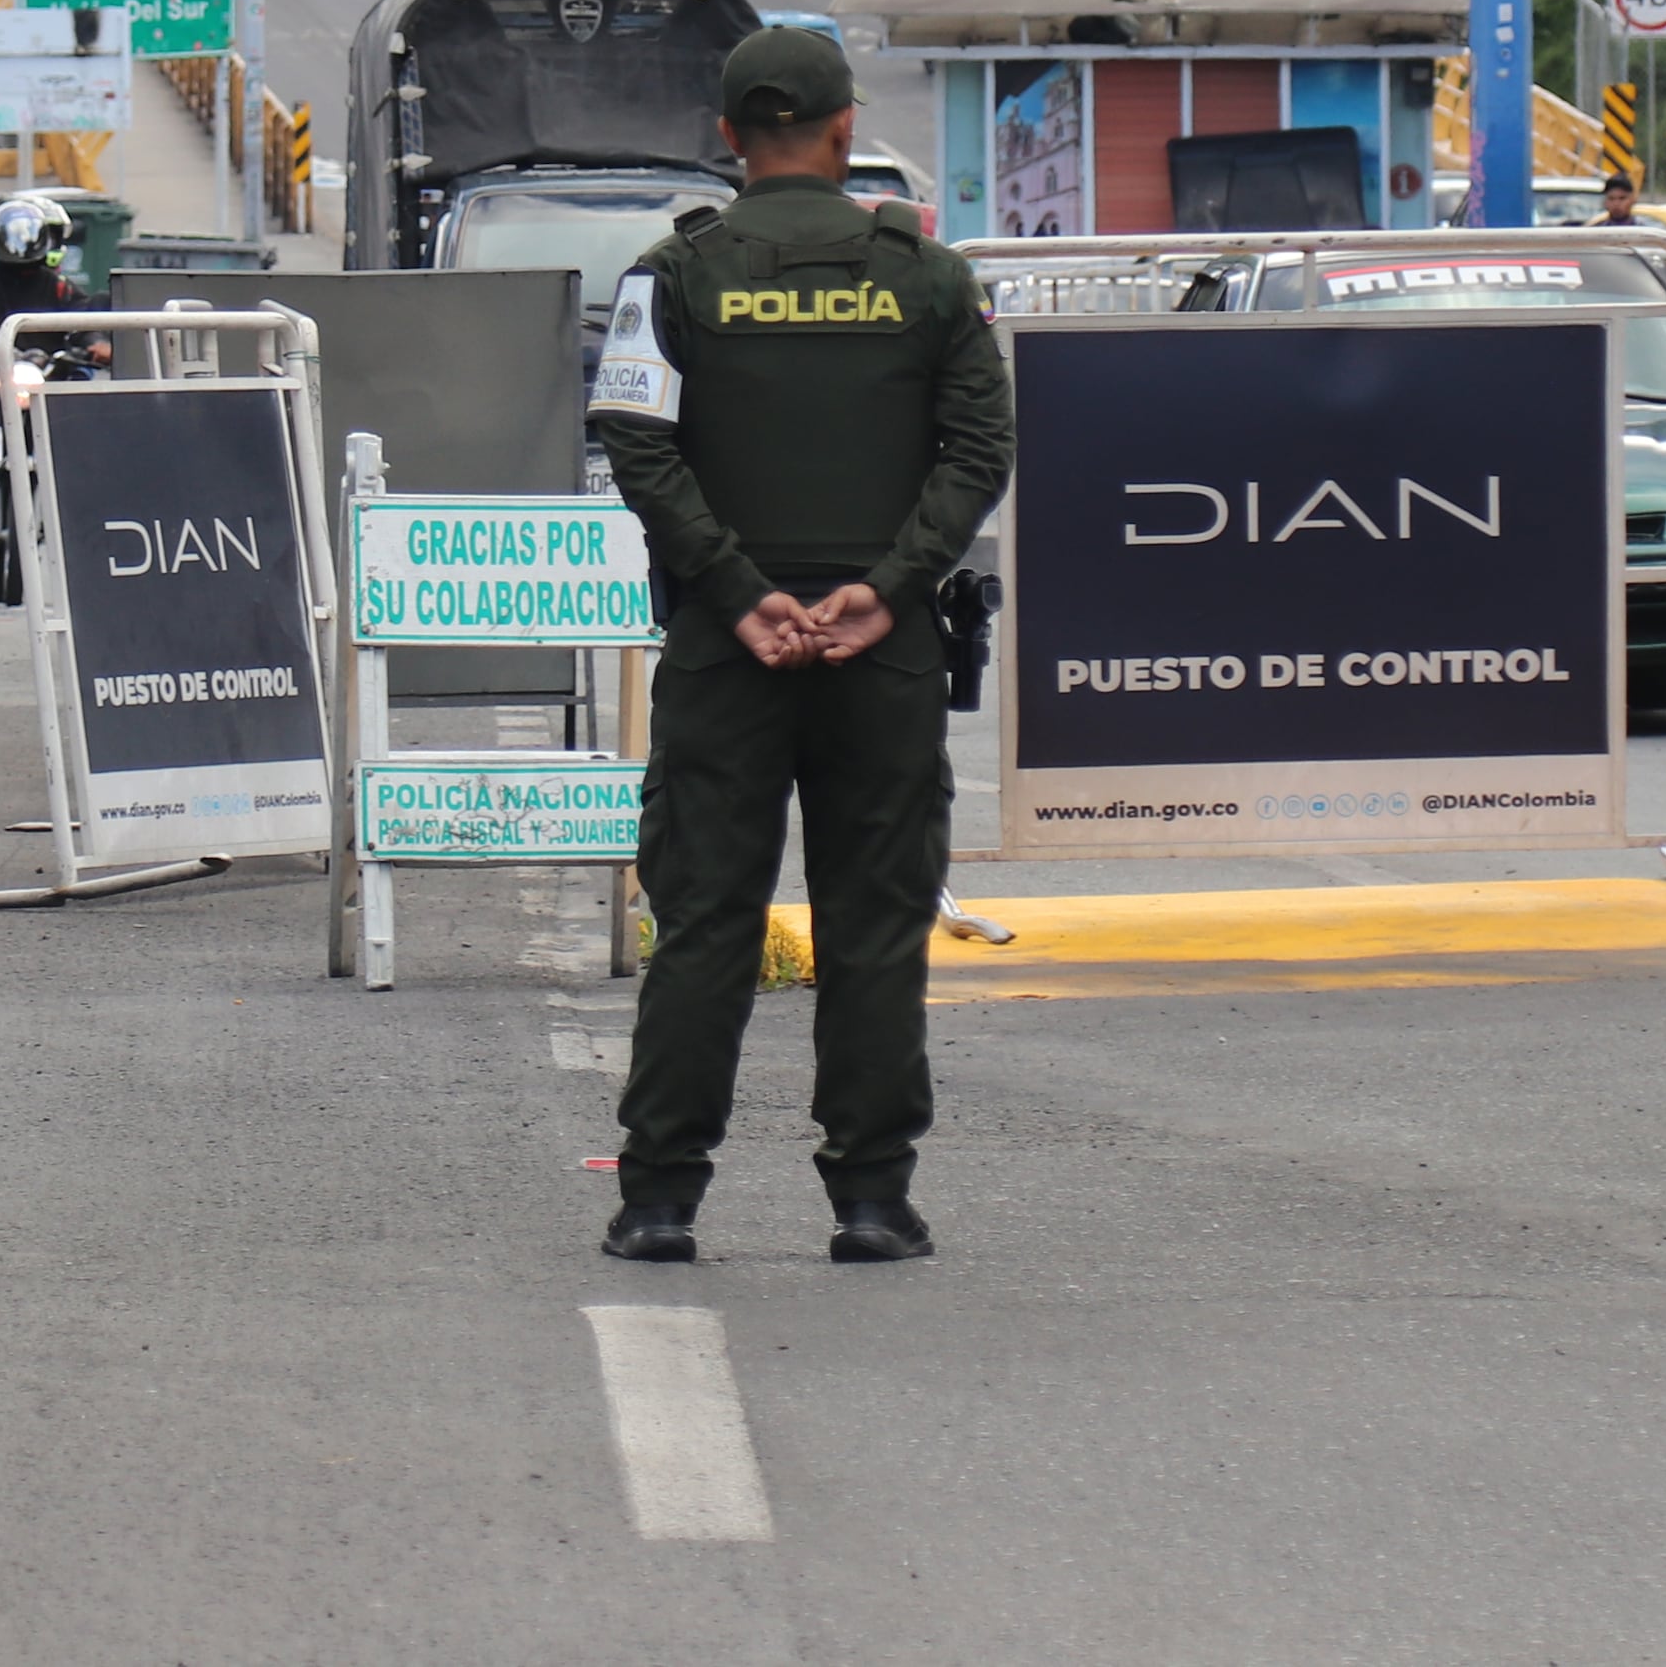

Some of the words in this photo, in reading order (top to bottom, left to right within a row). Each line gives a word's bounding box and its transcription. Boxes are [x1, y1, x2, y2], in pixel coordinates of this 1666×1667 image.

[128, 0, 162, 23] Del
[721, 281, 903, 324] POLICÍA
[1124, 475, 1501, 546] DIAN
[104, 516, 262, 577] DIAN
[407, 520, 537, 566] GRACIAS
[547, 520, 607, 566] POR
[367, 579, 406, 625] SU
[416, 579, 650, 626] COLABORACION
[93, 673, 177, 707] PUESTO
[179, 671, 210, 702] DE
[211, 666, 300, 701] CONTROL
[1057, 654, 1247, 694] PUESTO
[1259, 653, 1326, 689] DE
[1338, 647, 1571, 687] CONTROL
[99, 801, 186, 820] www.dian.gov.co
[253, 791, 323, 812] @DIANColombia
[378, 780, 493, 810] POLICÍA
[1035, 798, 1240, 823] www.dian.gov.co
[1421, 789, 1597, 814] @DIANColombia
